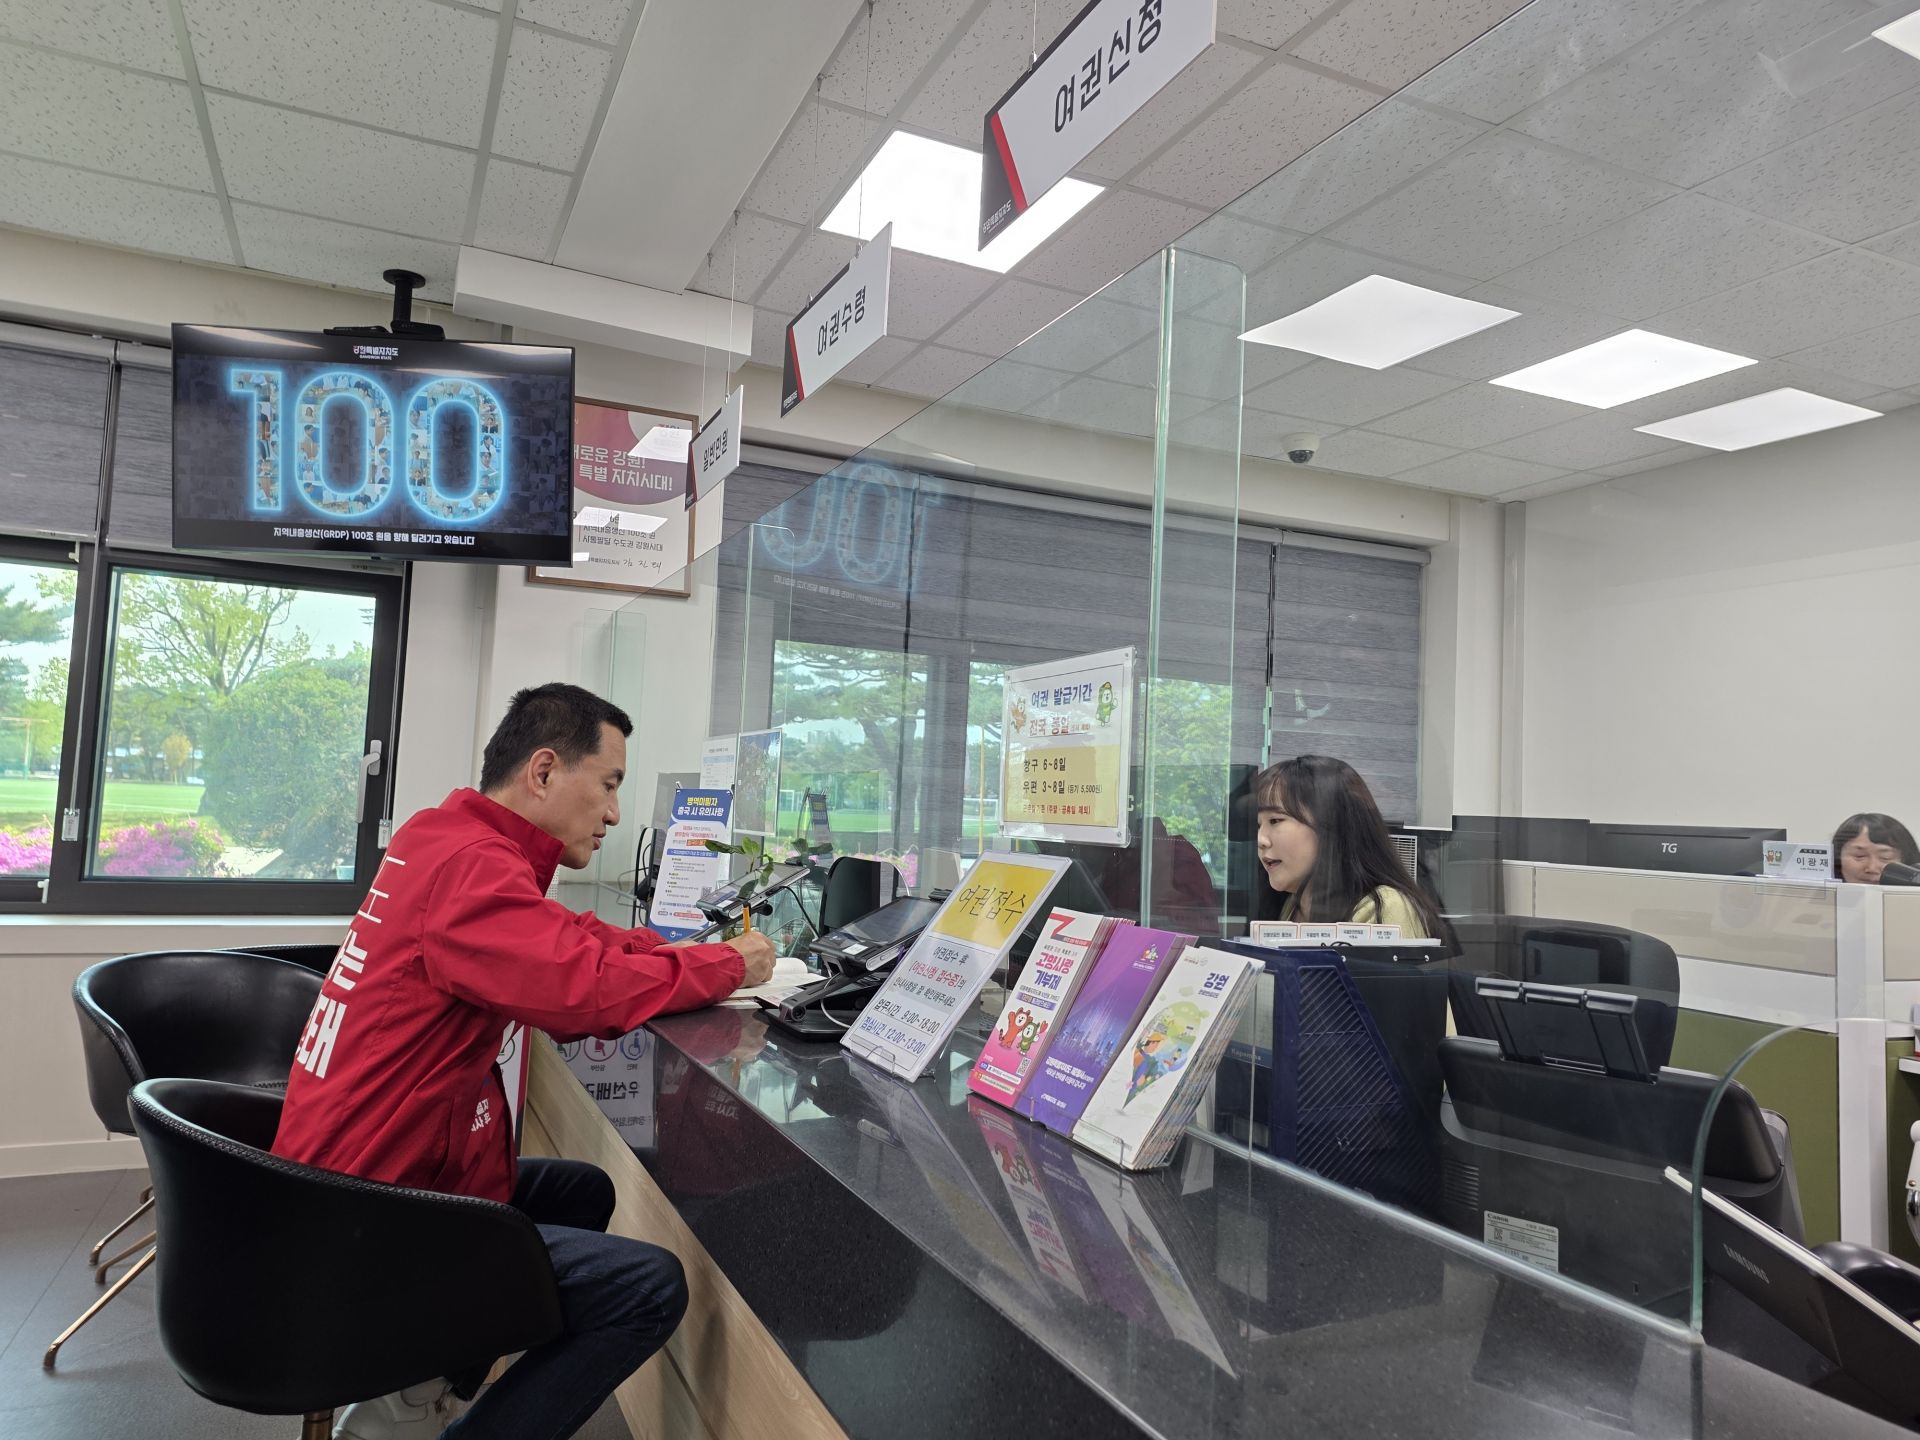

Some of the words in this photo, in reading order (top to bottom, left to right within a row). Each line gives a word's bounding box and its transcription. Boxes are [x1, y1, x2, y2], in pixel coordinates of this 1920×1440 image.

[817, 285, 866, 356] 여권수령
[226, 363, 509, 521] 100
[703, 428, 728, 472] 일반민원
[574, 443, 609, 464] 로운
[579, 463, 608, 483] 특별
[611, 468, 673, 492] 자치시대!
[273, 526, 350, 541] 지역내총생산(GRDP)
[351, 530, 374, 541] 100조
[411, 534, 443, 545] 달려가고
[444, 535, 476, 546] 있습니다
[613, 538, 635, 549] 수도권
[1031, 689, 1050, 710] 여권
[1053, 682, 1093, 706] 발급기간
[1029, 719, 1047, 737] 전국
[1051, 716, 1070, 736] 동일
[1024, 760, 1038, 774] 창구
[1043, 757, 1066, 773] 6~8일
[1022, 781, 1038, 796] 우편
[1042, 780, 1065, 795] 3~8일
[677, 806, 691, 816] 출국
[691, 807, 699, 816] 시
[699, 807, 725, 817] 유의사항
[687, 797, 718, 806] 병역미필자
[1661, 842, 1678, 854] TG
[959, 884, 1026, 925] 여권접수
[933, 946, 960, 963] 여권접수
[959, 953, 970, 966] 후
[1035, 951, 1074, 975] 고향사랑
[1034, 969, 1062, 991] 기부제
[1204, 972, 1230, 991] 강원
[874, 998, 902, 1017] 업무시간
[900, 1010, 941, 1034] 9:00~18:00
[861, 1016, 888, 1035] 점심시간
[884, 1027, 927, 1055] 12:00~13:00
[1487, 1213, 1509, 1223] Canon
[1723, 1243, 1770, 1284] SAMSUNG
